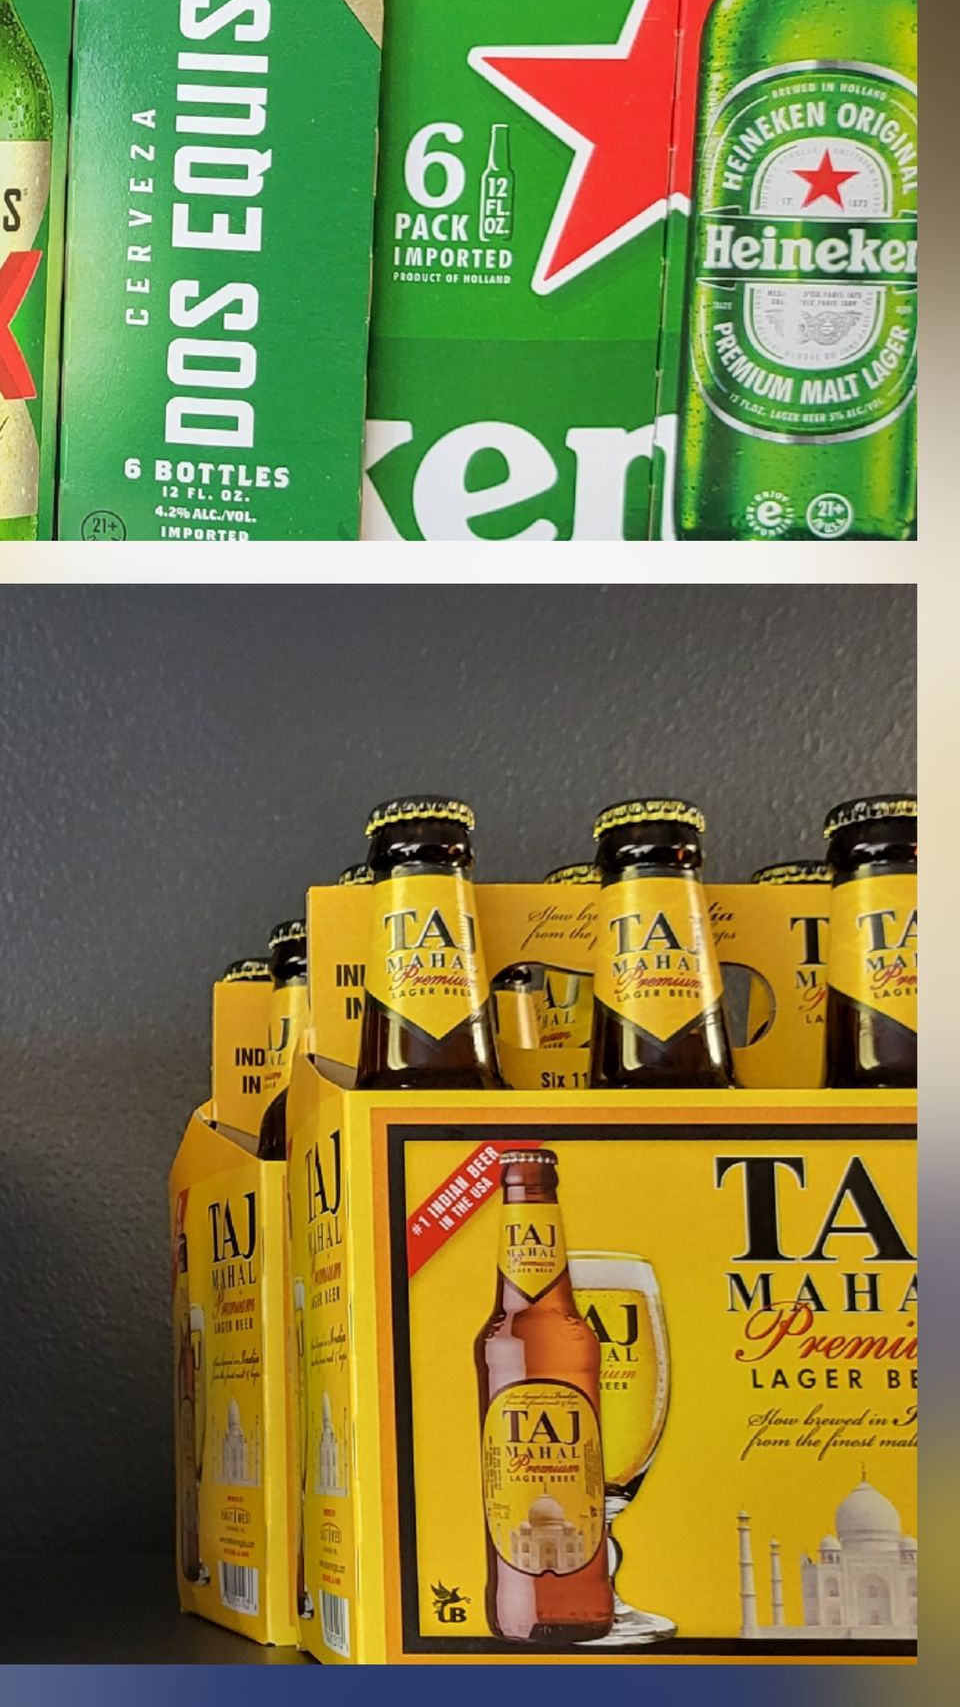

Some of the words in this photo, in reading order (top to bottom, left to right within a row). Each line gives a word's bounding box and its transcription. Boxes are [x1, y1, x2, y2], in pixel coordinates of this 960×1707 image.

[822, 83, 834, 92] IN
[841, 83, 887, 101] HOLLAND
[722, 101, 825, 191] HEINEKEN
[837, 103, 917, 194] ORIGINAL
[404, 122, 466, 208] 6
[488, 177, 508, 197] 12
[125, 108, 156, 326] CERVEZA
[486, 199, 511, 217] FL.
[394, 212, 469, 241] PACK
[484, 217, 510, 235] OZ.
[393, 248, 513, 269] IMPORTED
[393, 272, 443, 284] PRODUCT
[446, 273, 460, 284] OF
[463, 274, 511, 285] HOLLAND
[165, 278, 259, 448] DOS
[713, 321, 794, 404] PREMIUM
[800, 373, 860, 405] MALT
[861, 324, 910, 390] LAGER
[124, 458, 141, 480] 6
[154, 459, 290, 488] BOTTLES
[162, 486, 179, 498] 12
[187, 488, 213, 501] FL.
[220, 489, 250, 502] OZ.
[160, 526, 250, 541] IMPORTED
[384, 907, 476, 953] TAJ
[541, 1071, 565, 1088] Six
[411, 1212, 432, 1236] #1
[426, 1176, 469, 1219] INDIAN
[467, 1146, 500, 1179] BEER
[439, 1217, 455, 1231] IN
[452, 1196, 473, 1220] THE
[469, 1178, 494, 1199] USA
[505, 1223, 556, 1247] TAJ
[502, 1410, 581, 1445] TAJ
[748, 1403, 799, 1427] Slow
[803, 1403, 864, 1428] brewed
[868, 1411, 887, 1427] in
[740, 1425, 791, 1461] from
[795, 1428, 815, 1448] the
[817, 1425, 877, 1461] finest
[510, 1475, 543, 1483] LAGER
[550, 1475, 576, 1483] BEER
